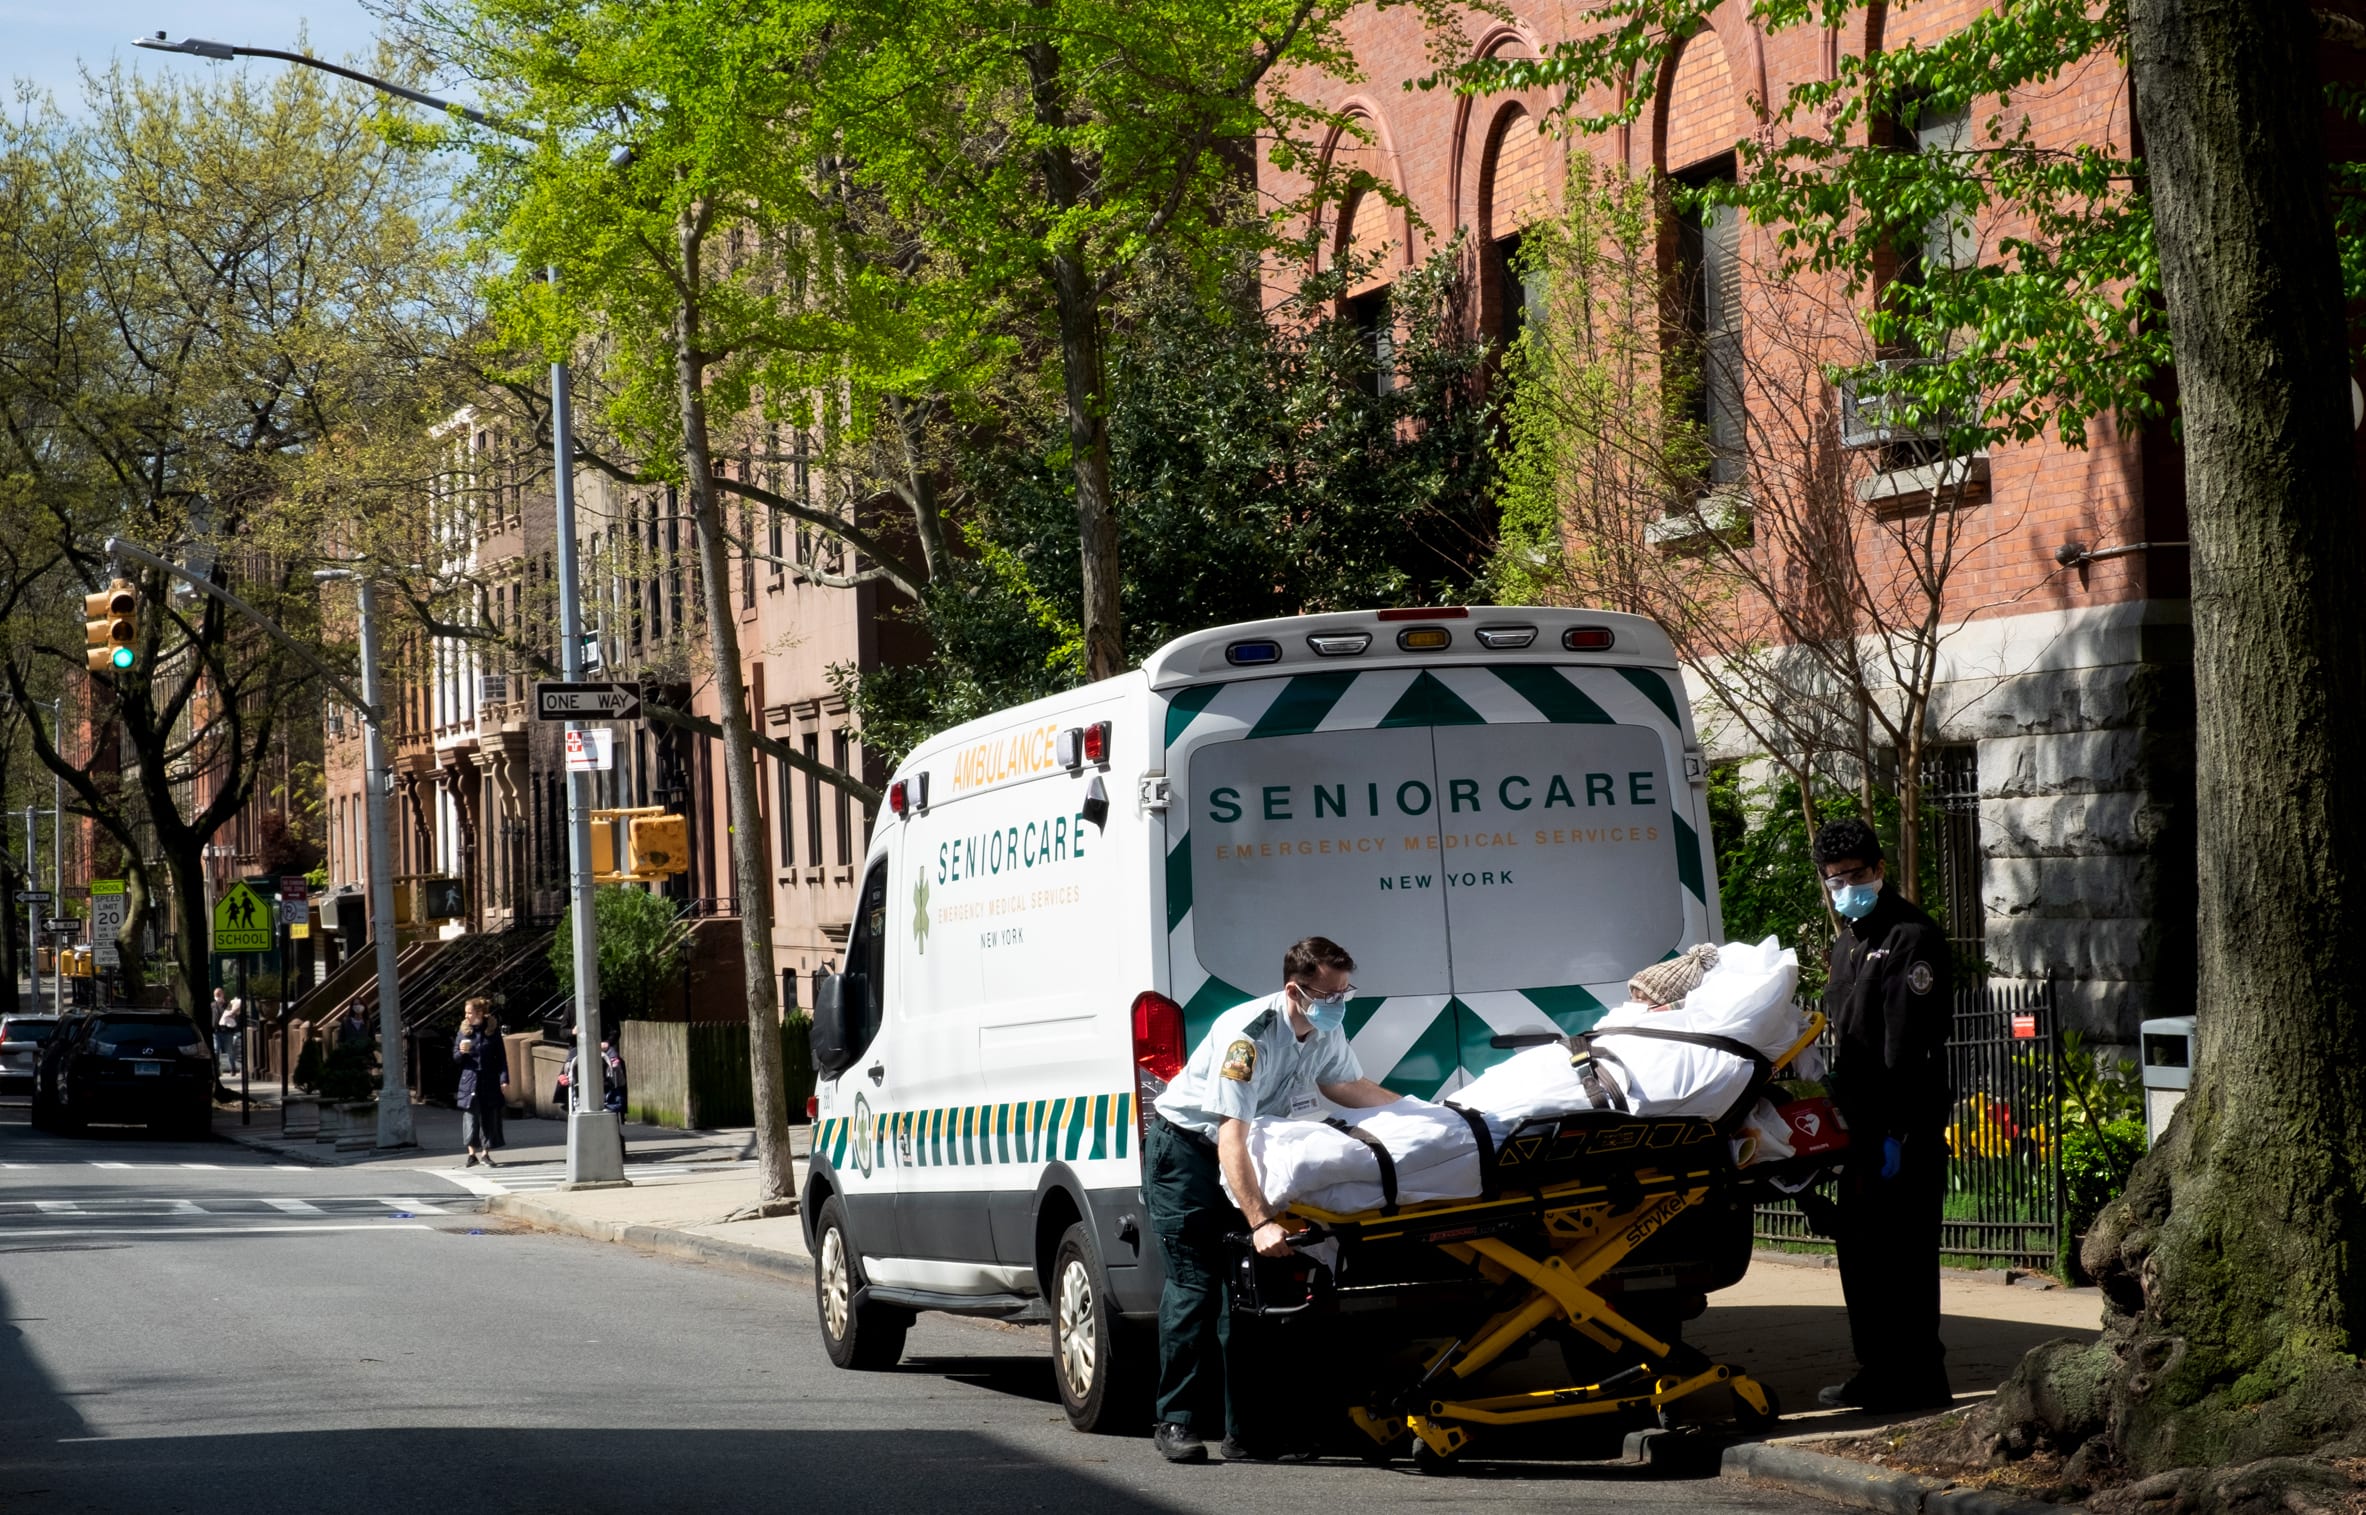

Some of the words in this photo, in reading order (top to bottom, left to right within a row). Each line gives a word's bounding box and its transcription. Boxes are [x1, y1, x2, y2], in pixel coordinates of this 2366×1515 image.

[546, 694, 580, 709] ONE
[597, 694, 629, 709] WAY
[952, 724, 1057, 792] AMBULANCE
[1208, 770, 1657, 823] SENIORCARE
[938, 812, 1085, 885] SENIORCARE
[1217, 838, 1386, 860] EMERGENCY
[1404, 831, 1519, 850] MEDICAL
[1535, 827, 1660, 845] SERVICES
[93, 884, 121, 892] SCHOOL
[1379, 875, 1432, 891] NEW
[1448, 870, 1514, 887] YORK
[95, 895, 121, 903] SPEED
[98, 903, 118, 911] LIMIT
[938, 901, 984, 924] EMERGENCY
[989, 895, 1027, 916] MEDICAL
[1032, 885, 1080, 910] SERVICES
[98, 911, 120, 925] 20
[217, 933, 266, 945] SCHOOL
[980, 931, 997, 949] NEW
[1000, 927, 1024, 946] YORK
[1627, 1195, 1687, 1248] stryker
